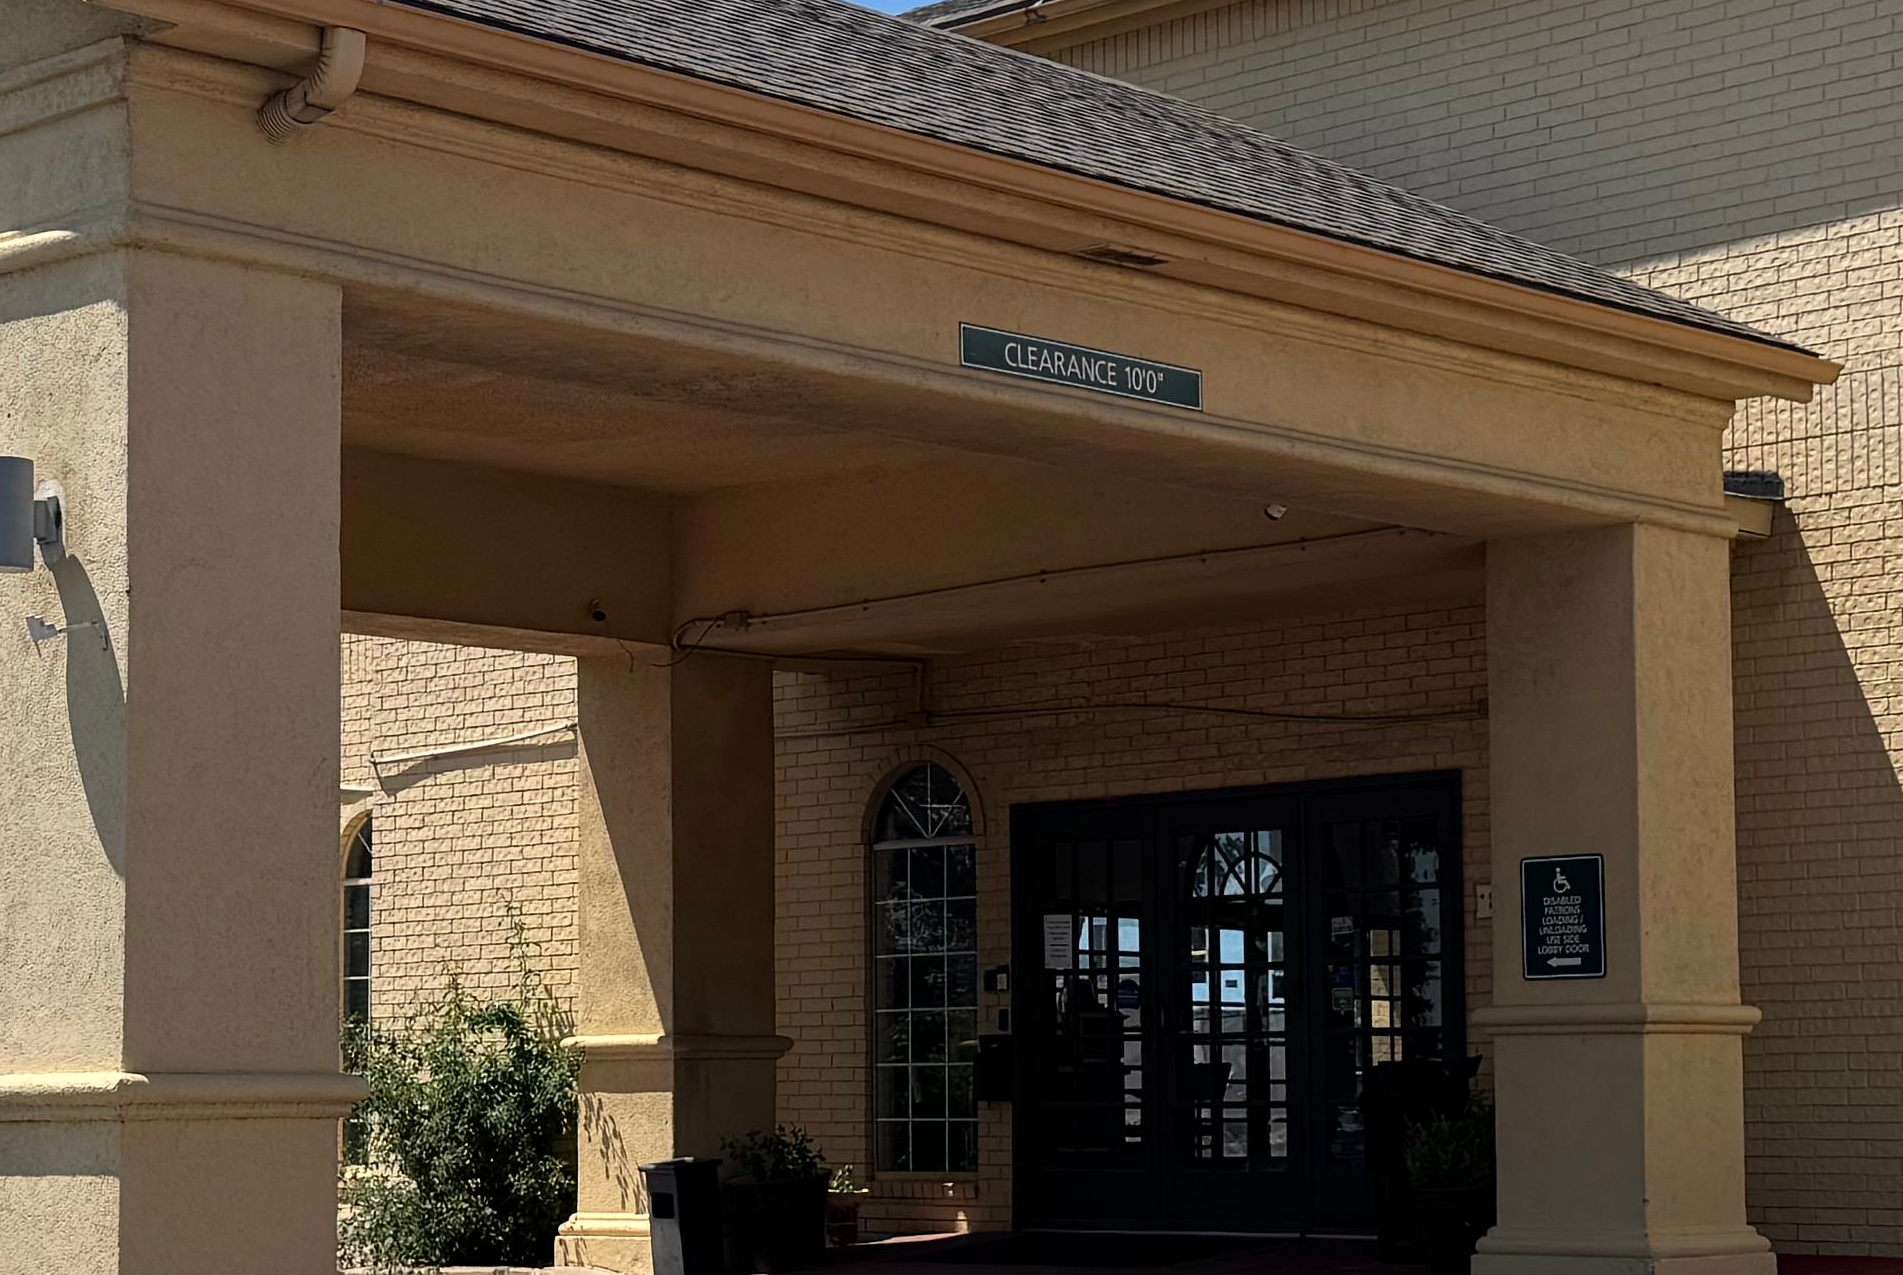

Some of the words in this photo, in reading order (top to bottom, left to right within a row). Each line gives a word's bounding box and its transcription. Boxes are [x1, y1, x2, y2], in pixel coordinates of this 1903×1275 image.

[1004, 342, 1118, 386] CLEARANCE
[1542, 915, 1578, 925] LOADING
[1538, 945, 1563, 955] LOBBY
[1565, 943, 1590, 954] DOOR
